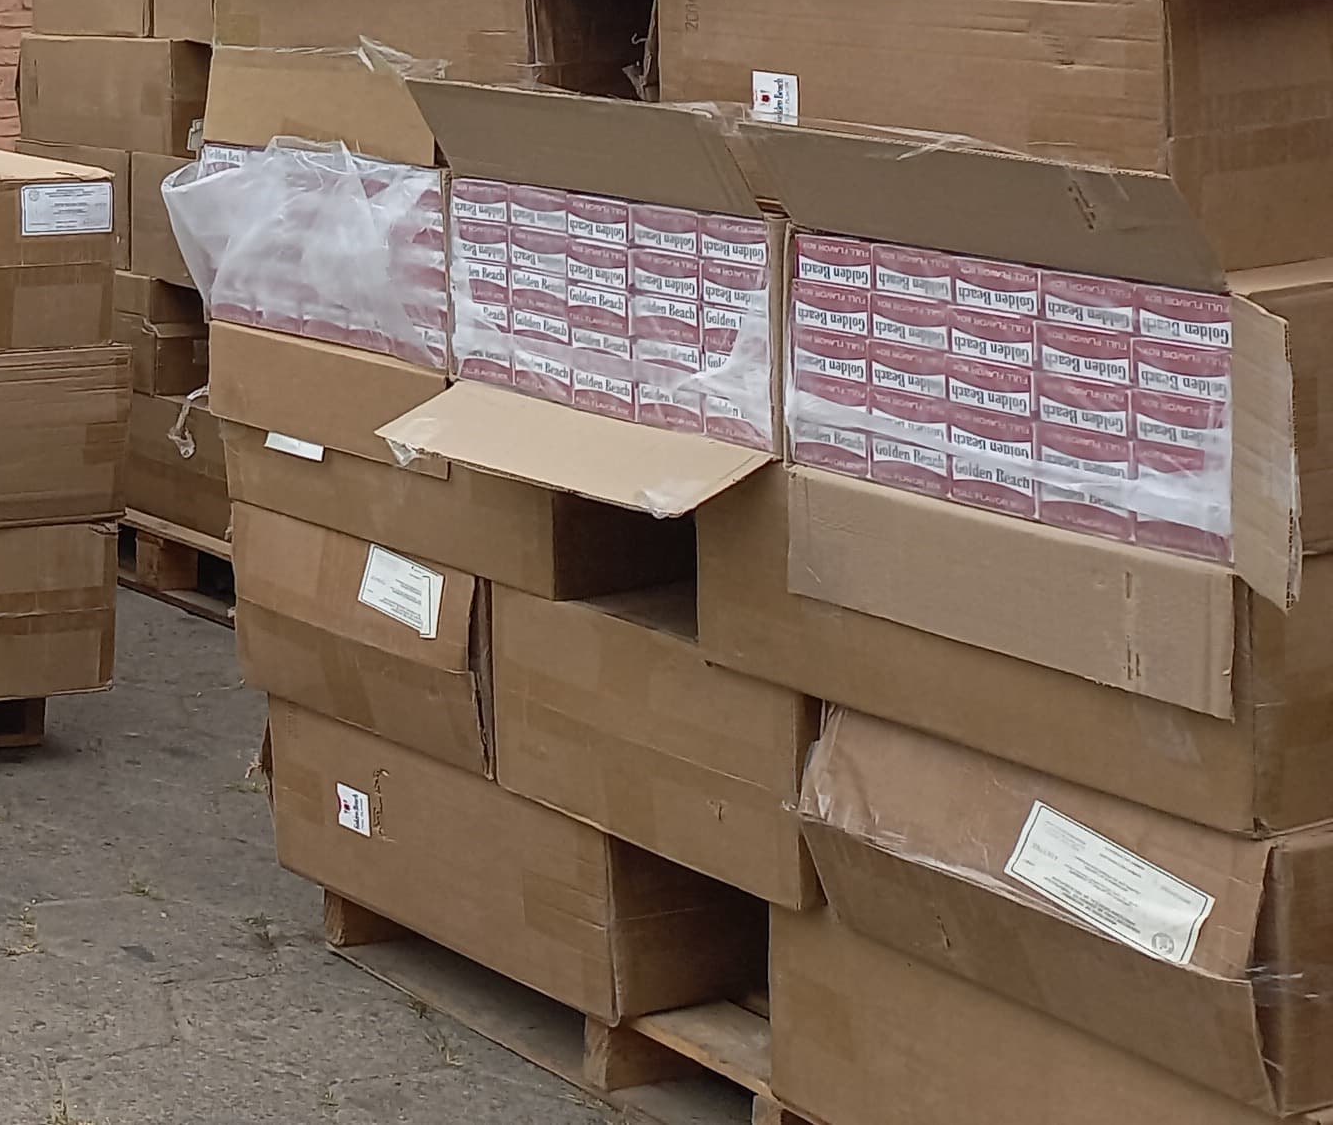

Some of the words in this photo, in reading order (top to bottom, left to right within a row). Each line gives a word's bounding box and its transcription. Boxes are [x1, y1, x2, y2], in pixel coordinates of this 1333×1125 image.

[454, 202, 477, 216] Beach
[569, 219, 594, 232] Beach
[595, 225, 624, 241] Golden
[664, 233, 695, 250] Golden
[703, 239, 730, 256] Beach
[732, 245, 765, 261] Golden
[848, 247, 870, 258] FULL
[483, 267, 505, 281] Beach
[569, 262, 593, 279] Beach
[595, 268, 624, 285] Golden
[801, 260, 831, 276] Beach
[832, 266, 869, 285] Golden
[513, 272, 540, 287] Golden
[664, 279, 695, 296] Golden
[878, 270, 910, 289] Beach
[912, 277, 949, 297] Golden
[569, 288, 597, 304] Golden
[599, 293, 624, 310] Beach
[705, 285, 732, 302] Beach
[958, 285, 992, 306] Beach
[994, 293, 1035, 313] Golden
[669, 303, 695, 320] Beach
[706, 310, 736, 328] Golden
[798, 306, 828, 325] Beach
[1048, 301, 1084, 321] Beach
[1087, 306, 1130, 329] Golden
[515, 312, 541, 330] Golden
[543, 319, 567, 337] Beach
[829, 312, 866, 332] Golden
[875, 320, 906, 340] Beach
[573, 331, 601, 348] Golden
[603, 337, 628, 354] Beach
[908, 327, 945, 348] Golden
[1184, 323, 1229, 344] Golden
[954, 335, 987, 355] Beach
[990, 342, 1031, 363] Golden
[671, 347, 698, 364] Beach
[1045, 351, 1081, 372] Beach
[544, 359, 569, 379] Beach
[829, 359, 865, 379] Golden
[874, 366, 906, 383] Beach
[1084, 359, 1126, 381] Golden
[575, 372, 603, 390] Golden
[605, 378, 630, 396] Beach
[1141, 369, 1179, 390] Beach
[641, 386, 670, 403] Golden
[952, 384, 984, 404] Beach
[988, 392, 1028, 413] Golden
[1043, 403, 1078, 424] Beach
[1081, 412, 1124, 433] Golden
[833, 432, 865, 451] Beach
[1139, 421, 1177, 442] Beach
[875, 441, 911, 462] Golden
[913, 448, 945, 470] Beach
[955, 460, 993, 482] Golden
[995, 468, 1031, 490] Beach
